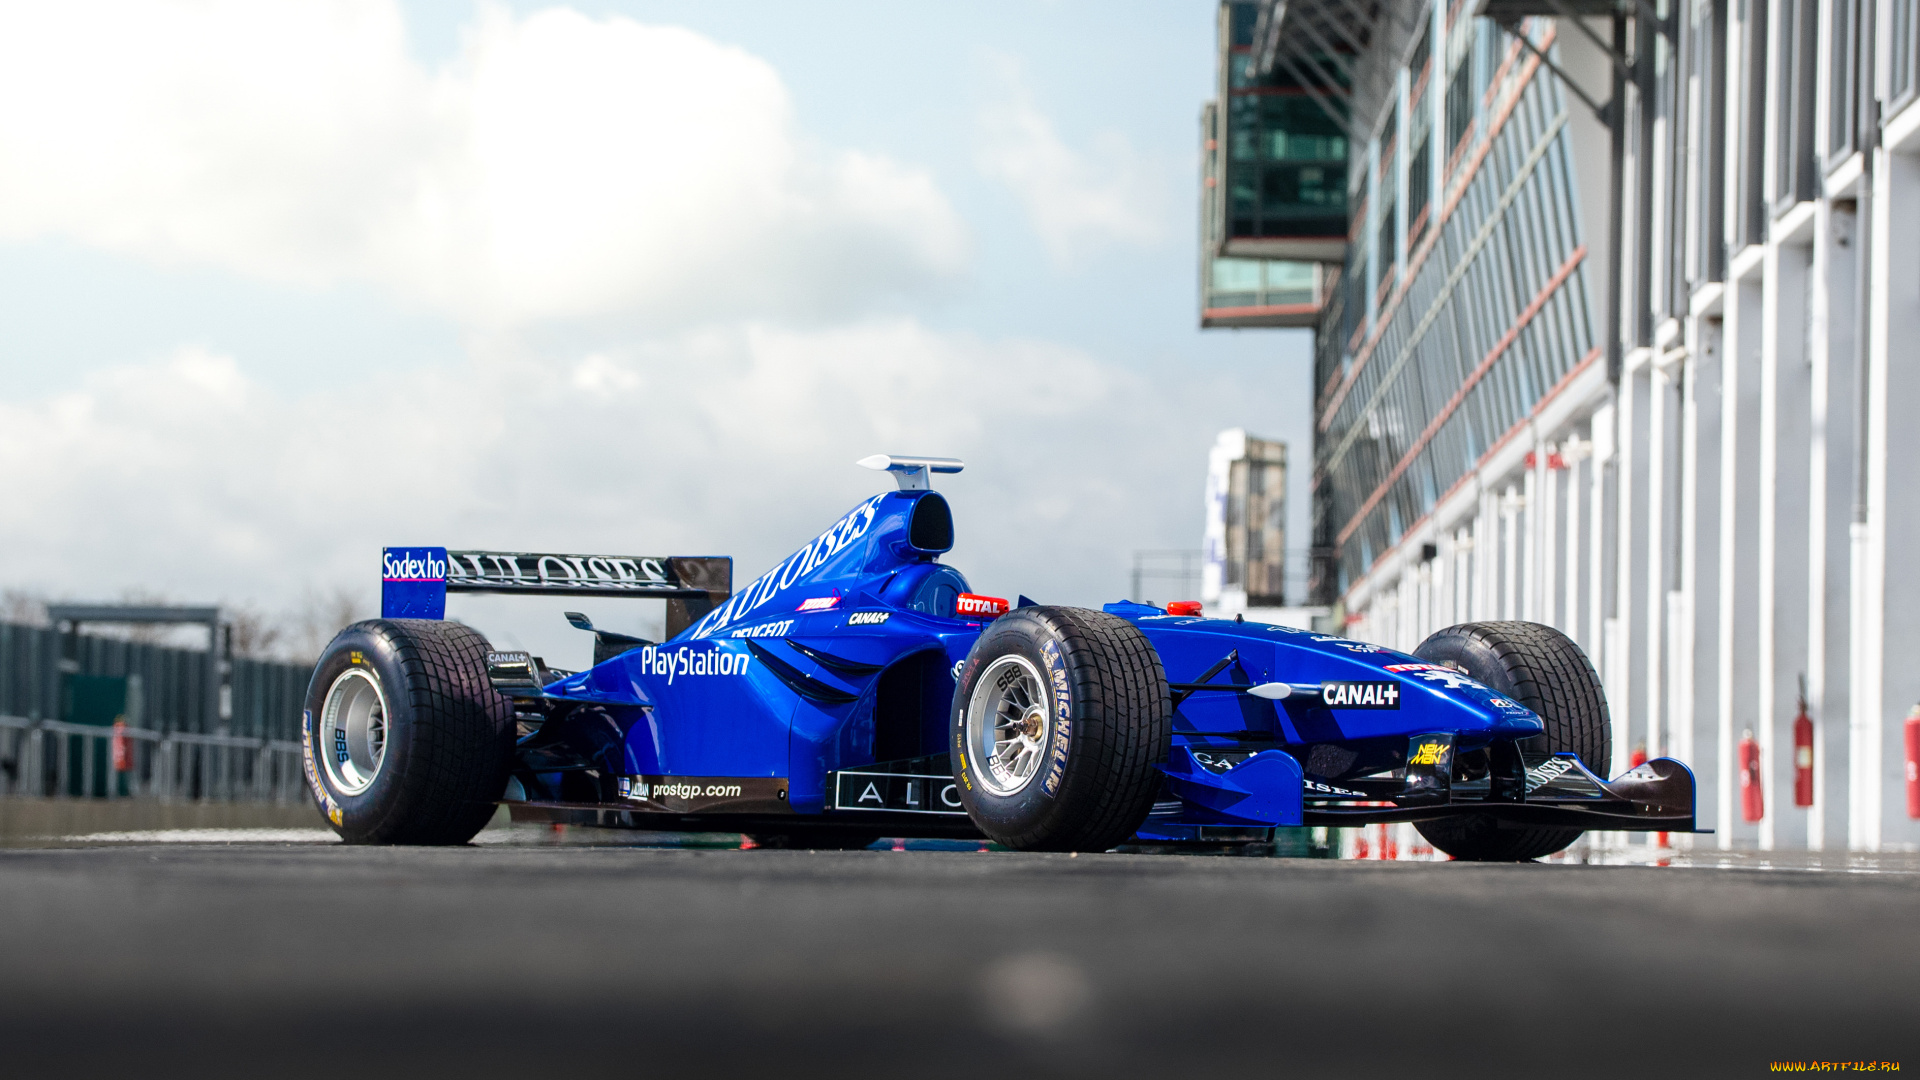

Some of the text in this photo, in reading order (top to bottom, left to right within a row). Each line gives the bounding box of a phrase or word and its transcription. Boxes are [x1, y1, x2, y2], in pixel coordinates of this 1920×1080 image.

[383, 551, 445, 579] Sodexho
[690, 492, 888, 641] GAULOISES
[848, 612, 890, 625] CANAL+
[957, 597, 1000, 614] TOTAL
[488, 653, 526, 662] CANAL+
[641, 646, 750, 685] PlayStation
[997, 665, 1022, 692] BBS
[1323, 684, 1399, 705] CANAL+
[1045, 668, 1072, 793] MICHELIN
[335, 728, 349, 762] BBS
[986, 754, 1012, 783] BBS
[653, 783, 741, 799] prostgp.com
